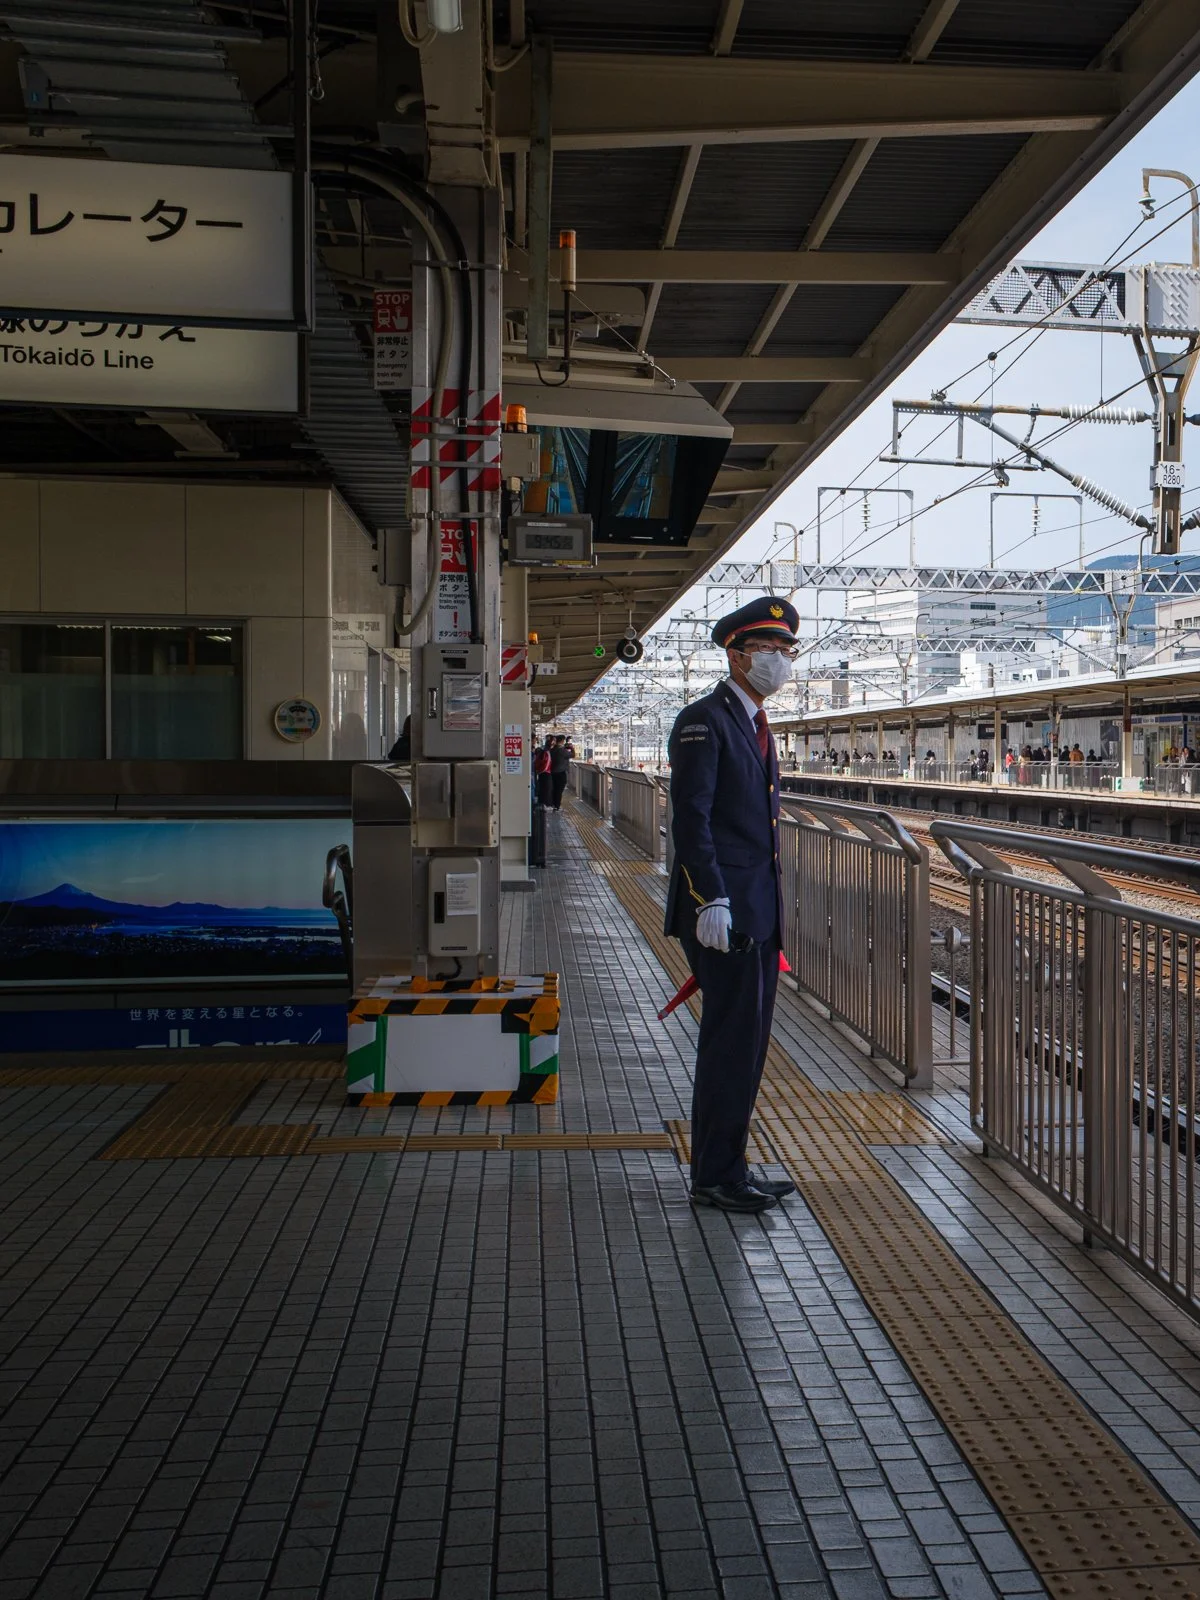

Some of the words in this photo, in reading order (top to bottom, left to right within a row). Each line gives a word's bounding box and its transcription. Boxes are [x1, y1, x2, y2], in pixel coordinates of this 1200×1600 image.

[376, 294, 410, 305] STOP
[0, 345, 95, 367] Tōkaidō
[104, 349, 154, 370] Line
[377, 349, 409, 358] ボタン
[440, 528, 475, 540] STO
[129, 1006, 304, 1022] 世界を変える星となる。
